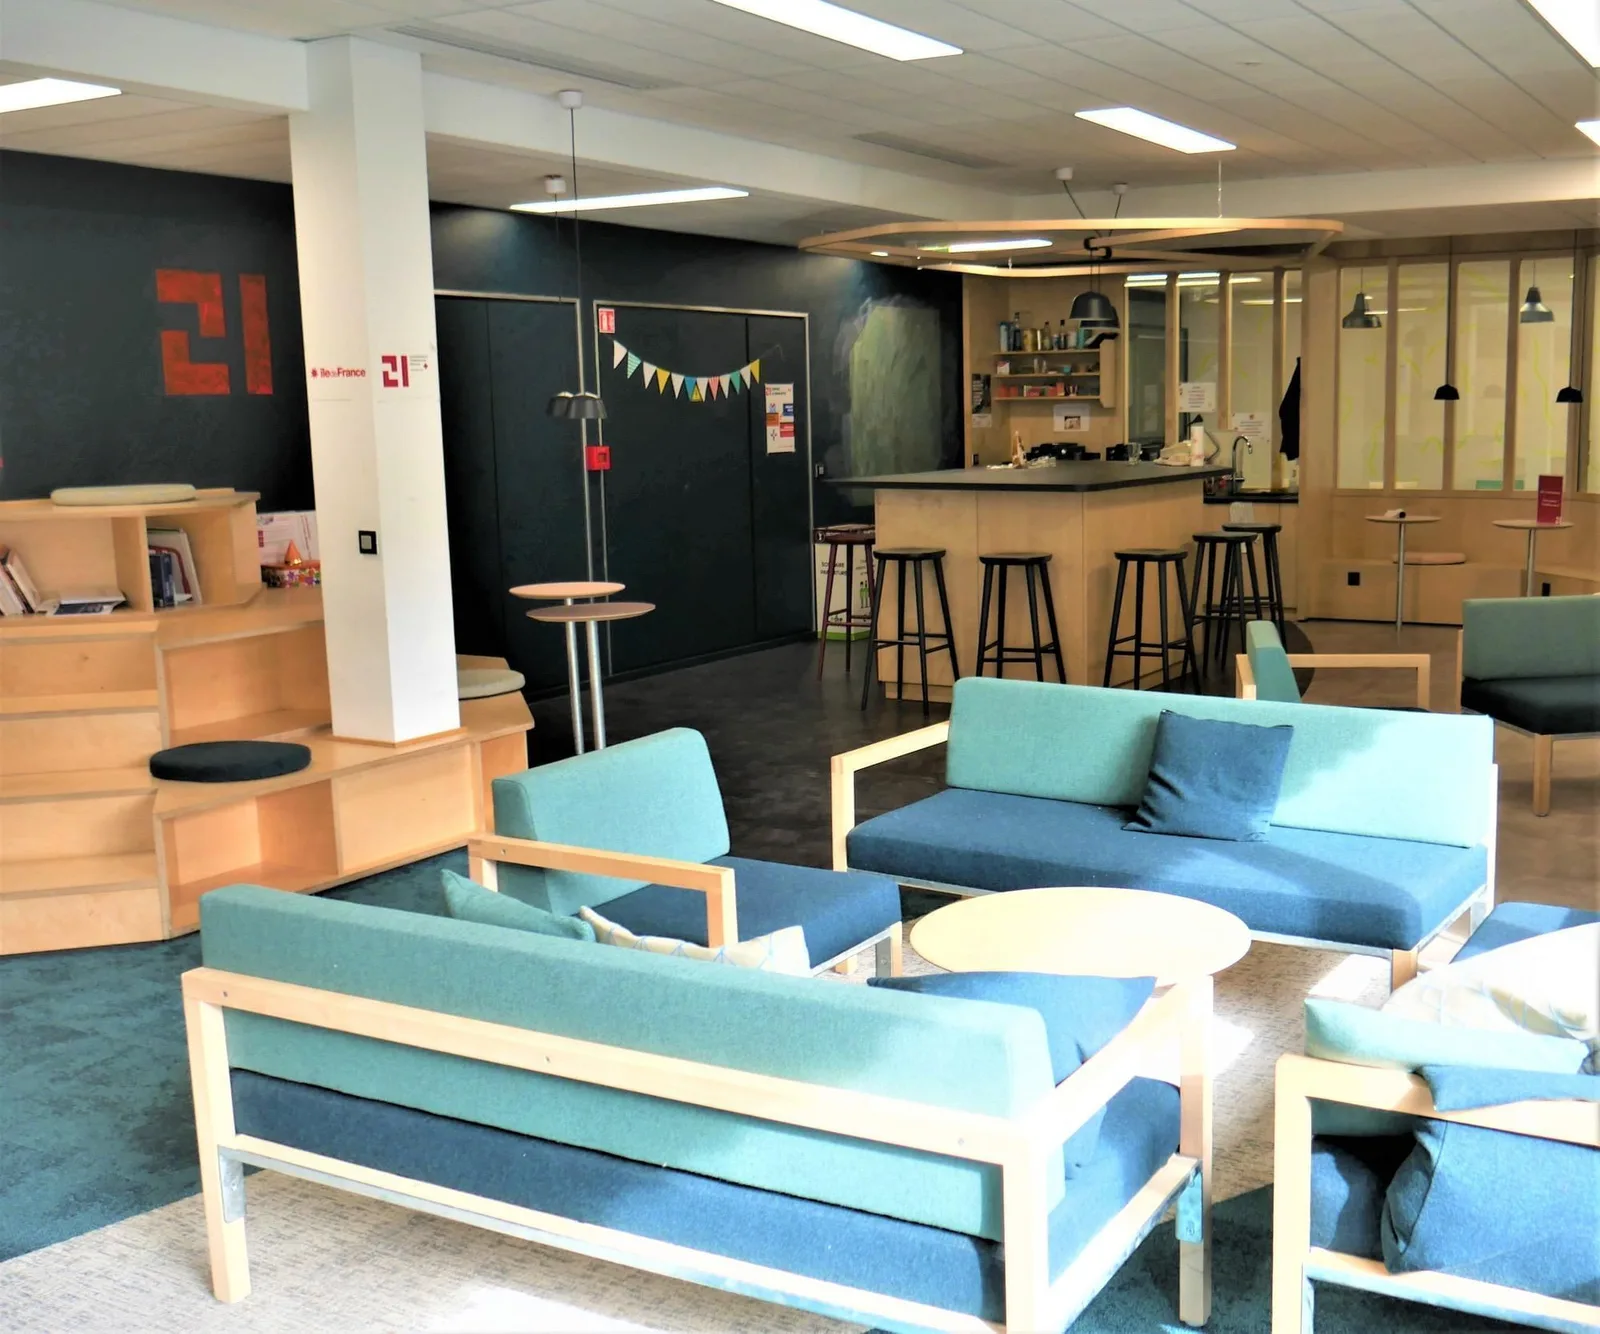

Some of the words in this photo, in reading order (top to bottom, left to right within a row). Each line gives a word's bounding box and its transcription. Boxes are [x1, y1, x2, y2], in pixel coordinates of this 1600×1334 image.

[156, 269, 273, 395] 21
[337, 367, 366, 378] France
[381, 355, 409, 388] 21
